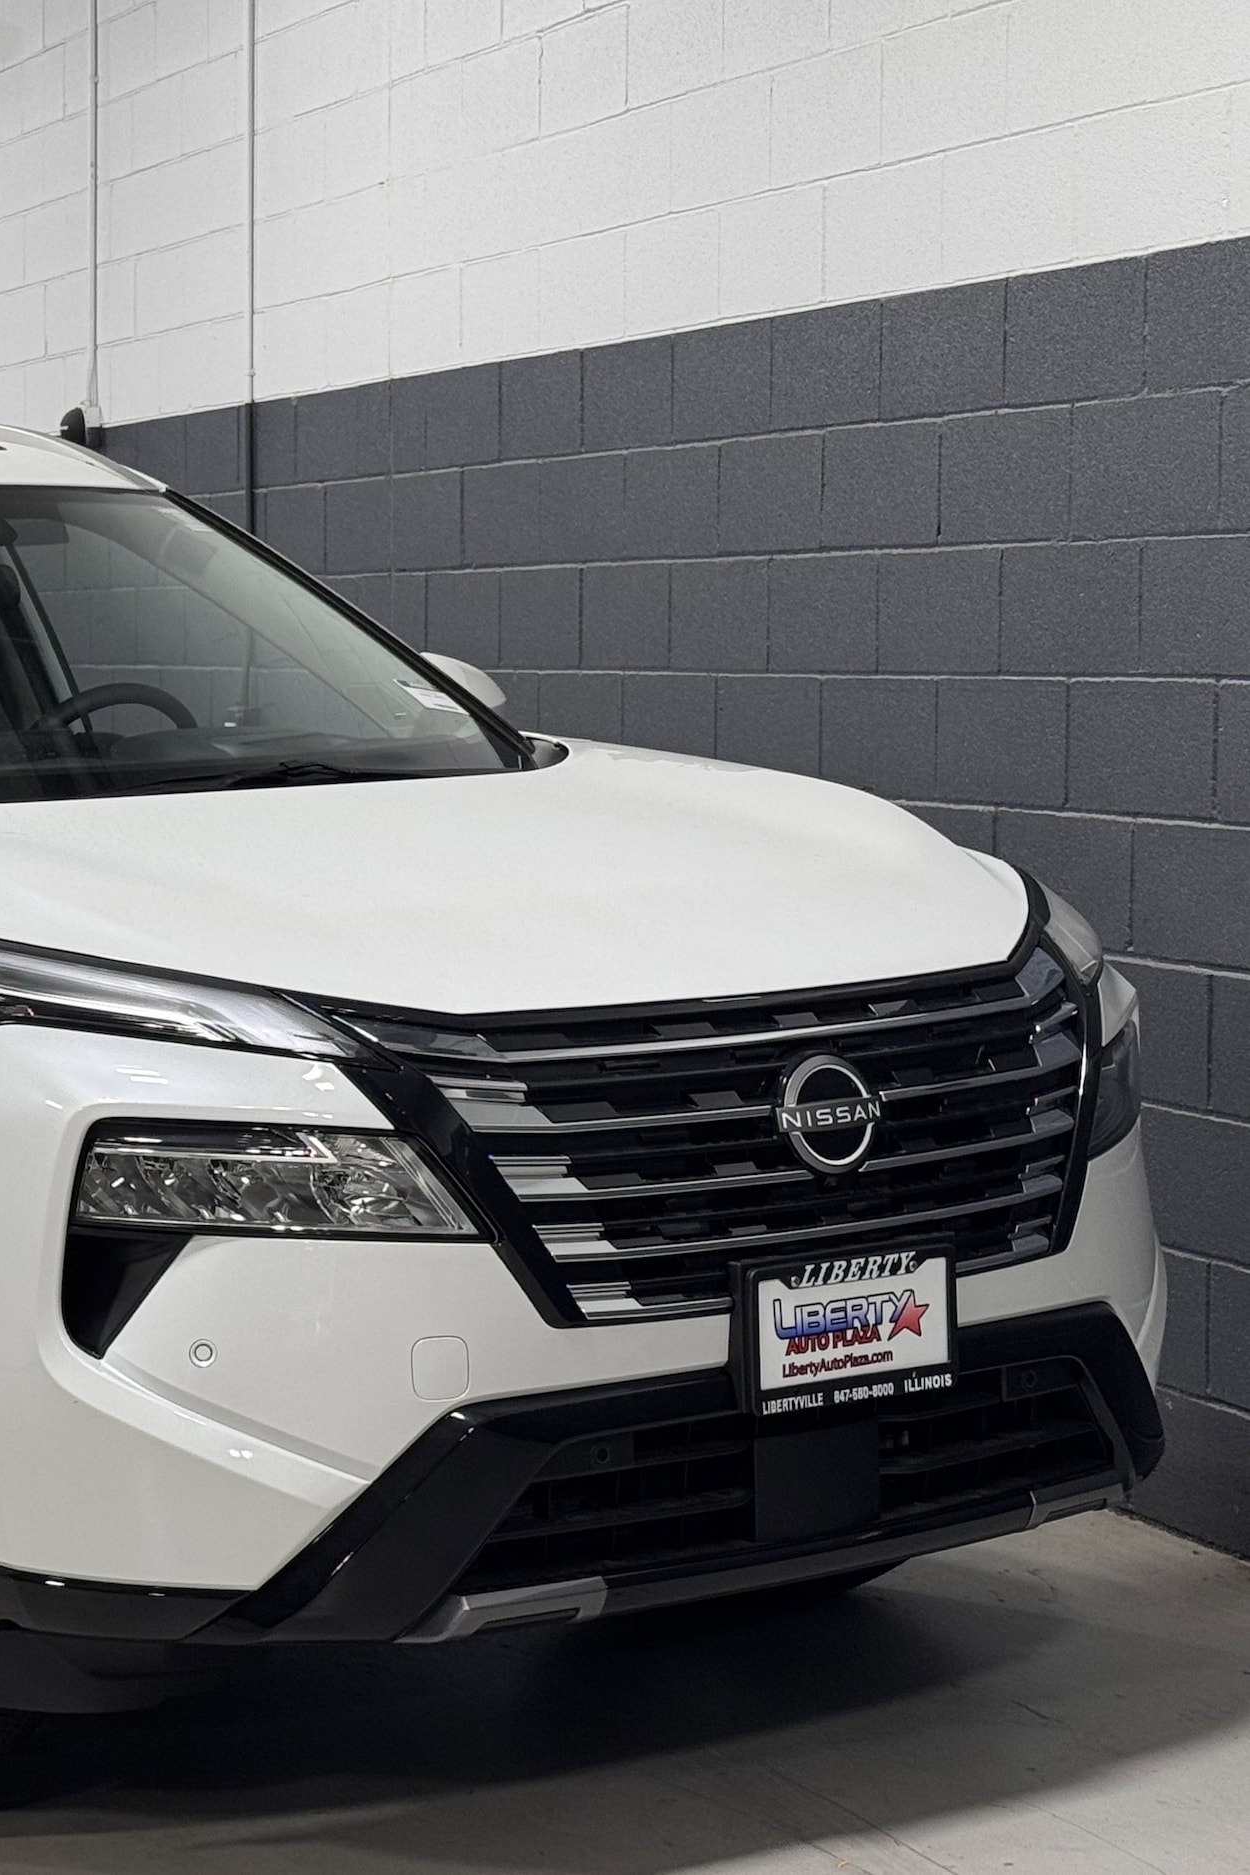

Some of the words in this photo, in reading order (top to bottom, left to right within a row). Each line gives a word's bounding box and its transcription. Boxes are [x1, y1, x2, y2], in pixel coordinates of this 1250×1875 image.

[781, 1101, 881, 1129] NISSAN
[799, 1251, 916, 1288] LIBERTY
[773, 1289, 915, 1340] LIBERTY
[785, 1334, 830, 1356] AUTO
[832, 1324, 881, 1349] PLAZA
[782, 1350, 893, 1378] LibertyAutoPlaza.com
[763, 1392, 824, 1415] LIBERTYVILLE
[904, 1373, 952, 1393] ILLINOIS
